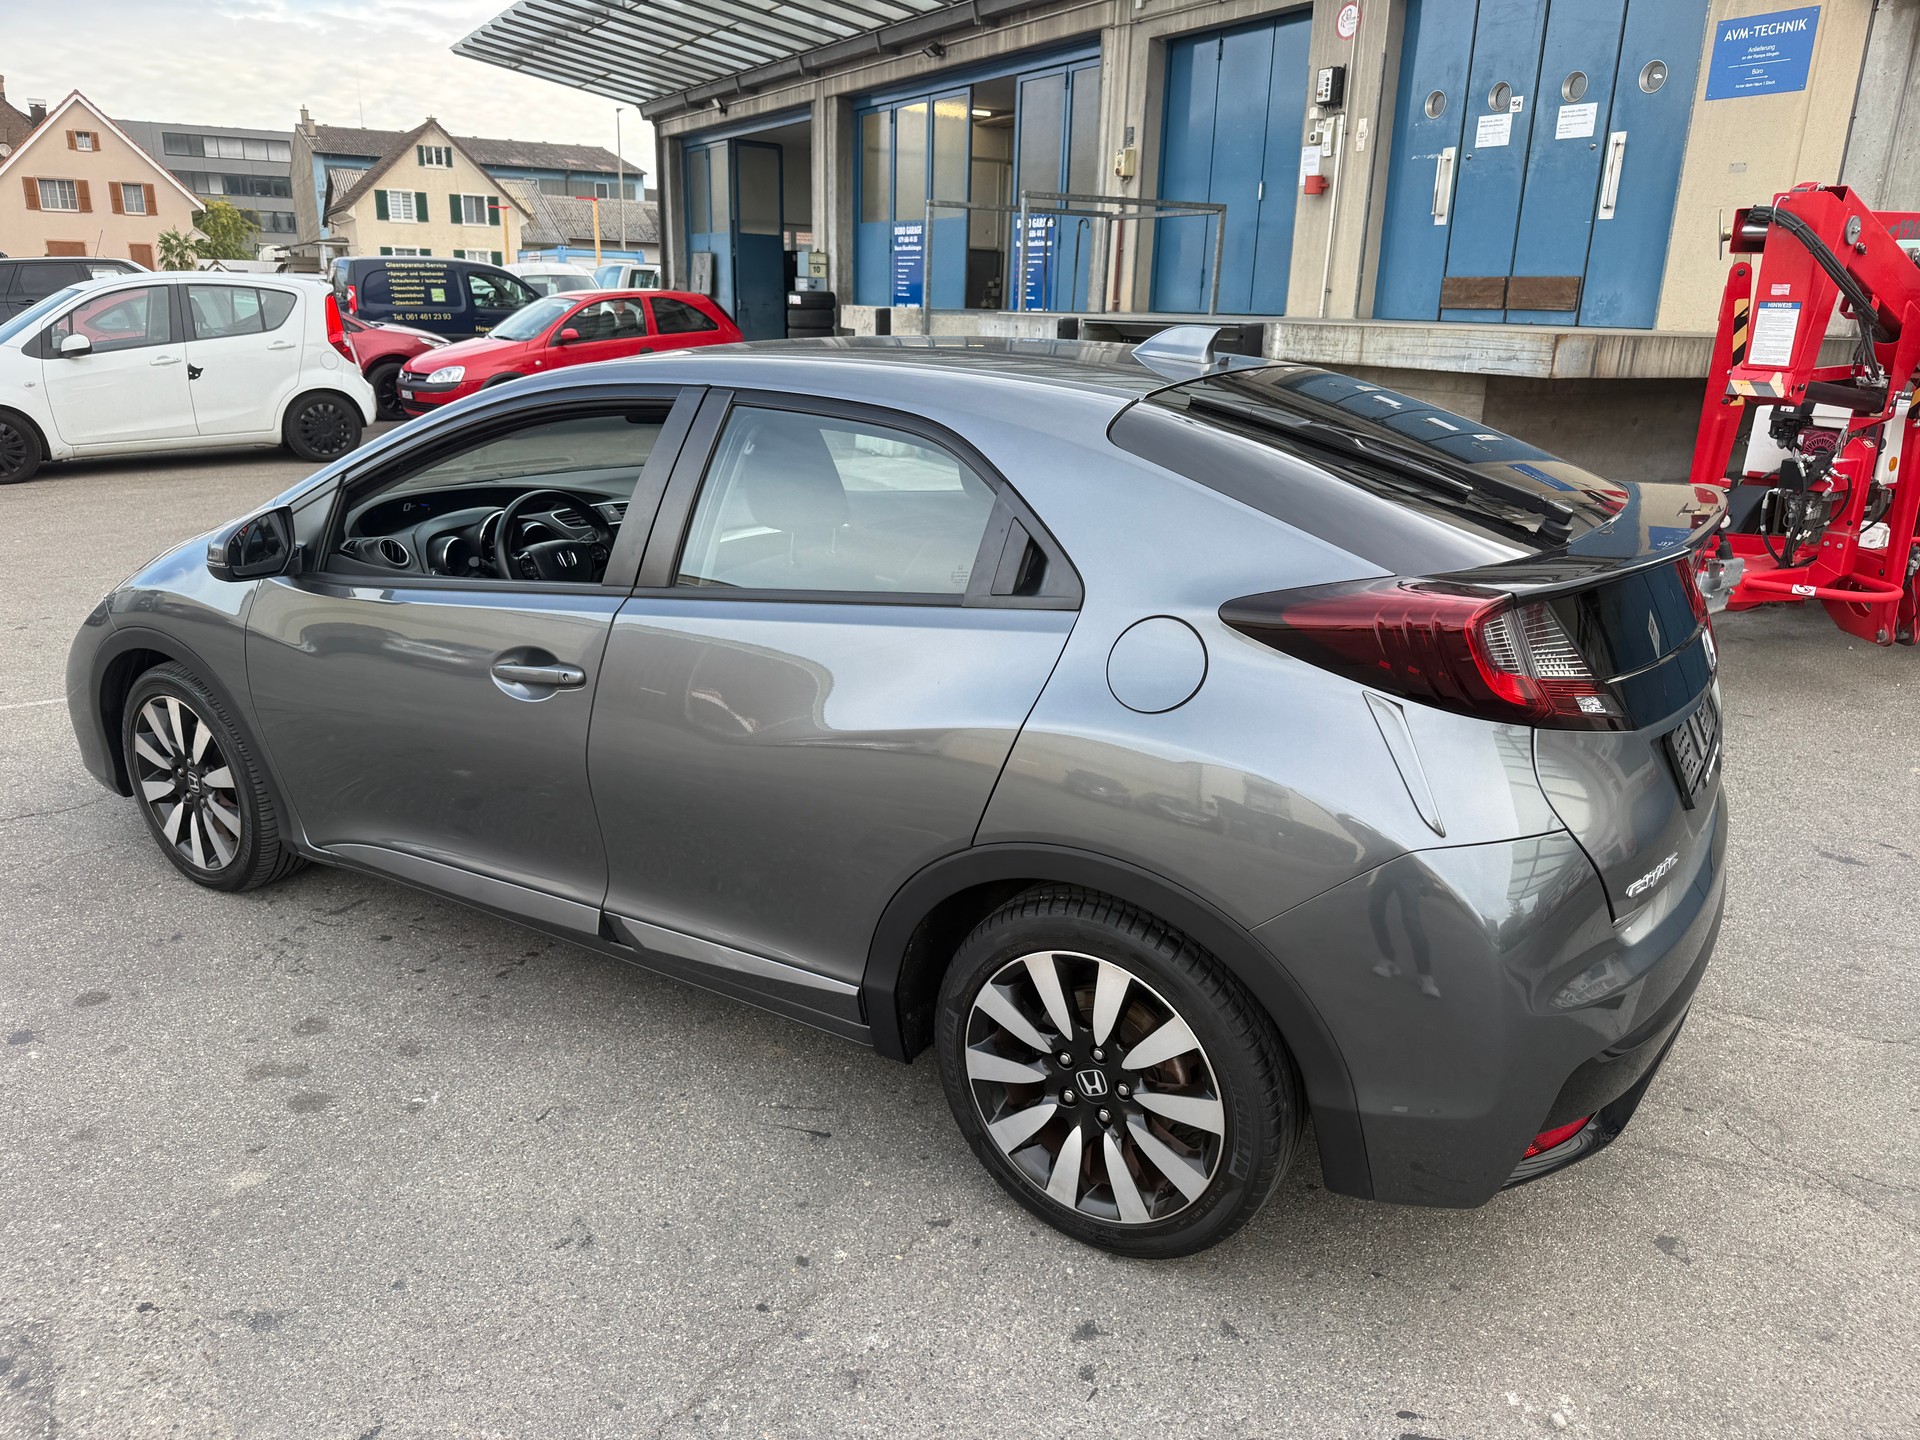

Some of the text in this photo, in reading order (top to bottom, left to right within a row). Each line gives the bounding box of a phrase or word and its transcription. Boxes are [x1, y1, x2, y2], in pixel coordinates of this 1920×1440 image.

[1723, 18, 1808, 42] AVM-TECHNIK
[1747, 44, 1776, 53] Anlieferung
[906, 225, 922, 234] GARAGE
